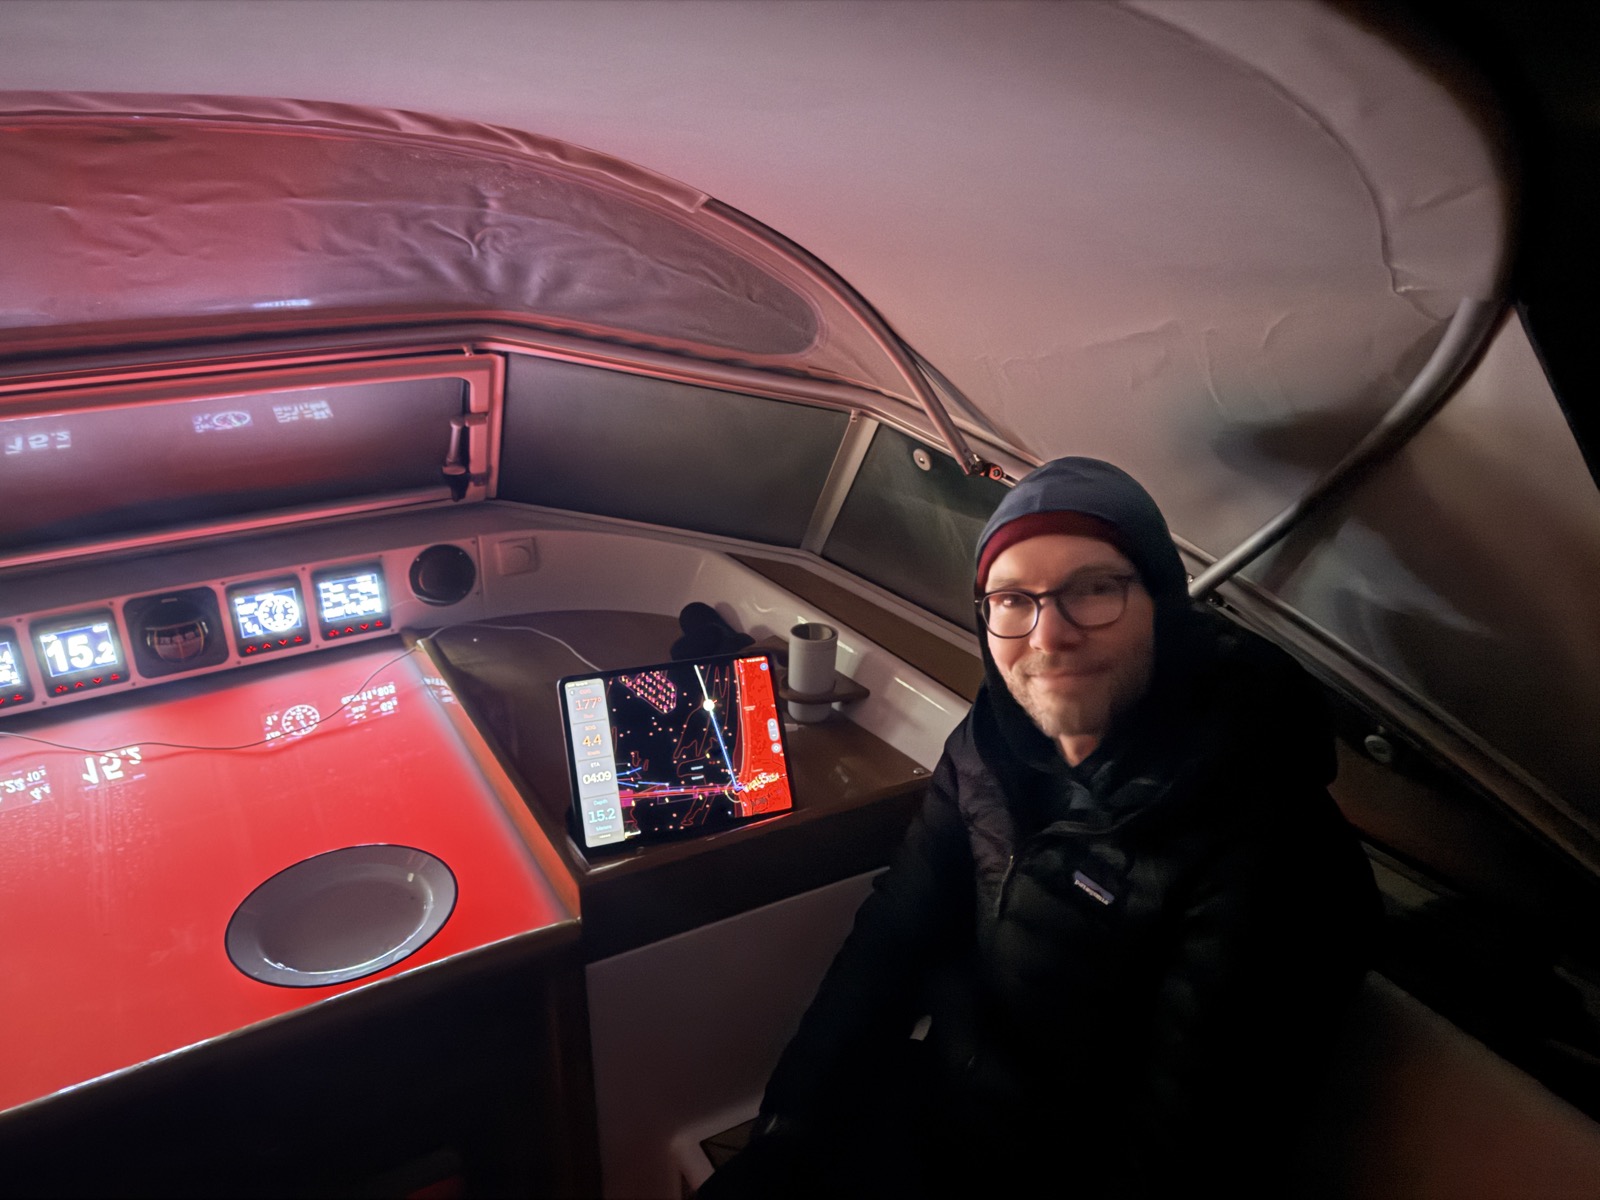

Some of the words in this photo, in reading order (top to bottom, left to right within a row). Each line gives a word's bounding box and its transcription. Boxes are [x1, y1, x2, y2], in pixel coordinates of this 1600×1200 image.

[582, 733, 602, 747] 4.4
[582, 770, 612, 785] 04:09
[593, 798, 609, 806] Depth
[587, 807, 616, 824] 15.2
